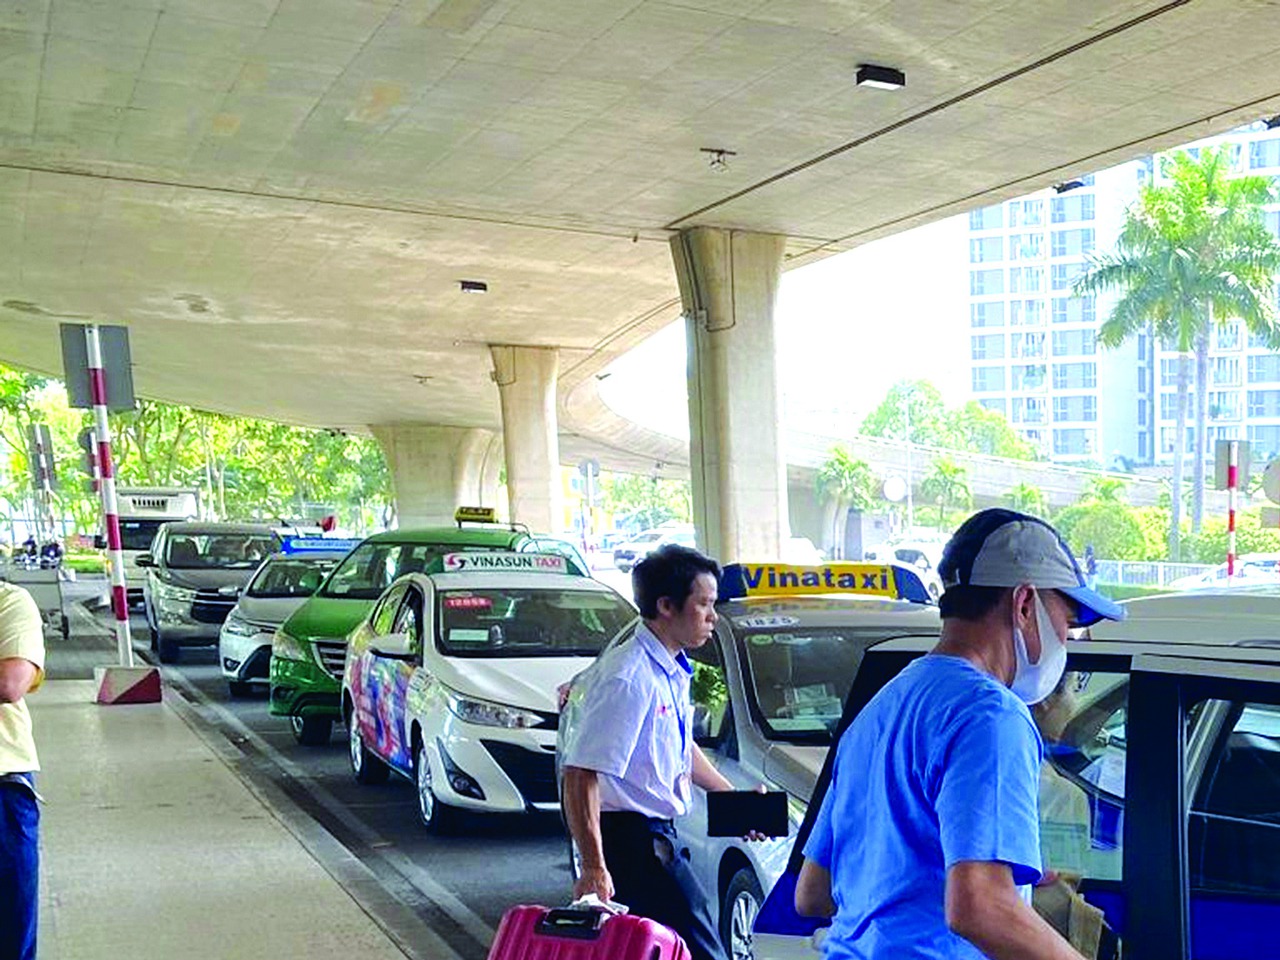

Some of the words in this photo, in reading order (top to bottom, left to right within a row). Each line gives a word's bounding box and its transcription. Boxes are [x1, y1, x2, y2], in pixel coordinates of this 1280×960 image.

[470, 555, 532, 568] VINASUN
[534, 556, 561, 568] TAXI
[745, 566, 888, 590] Vinataxi
